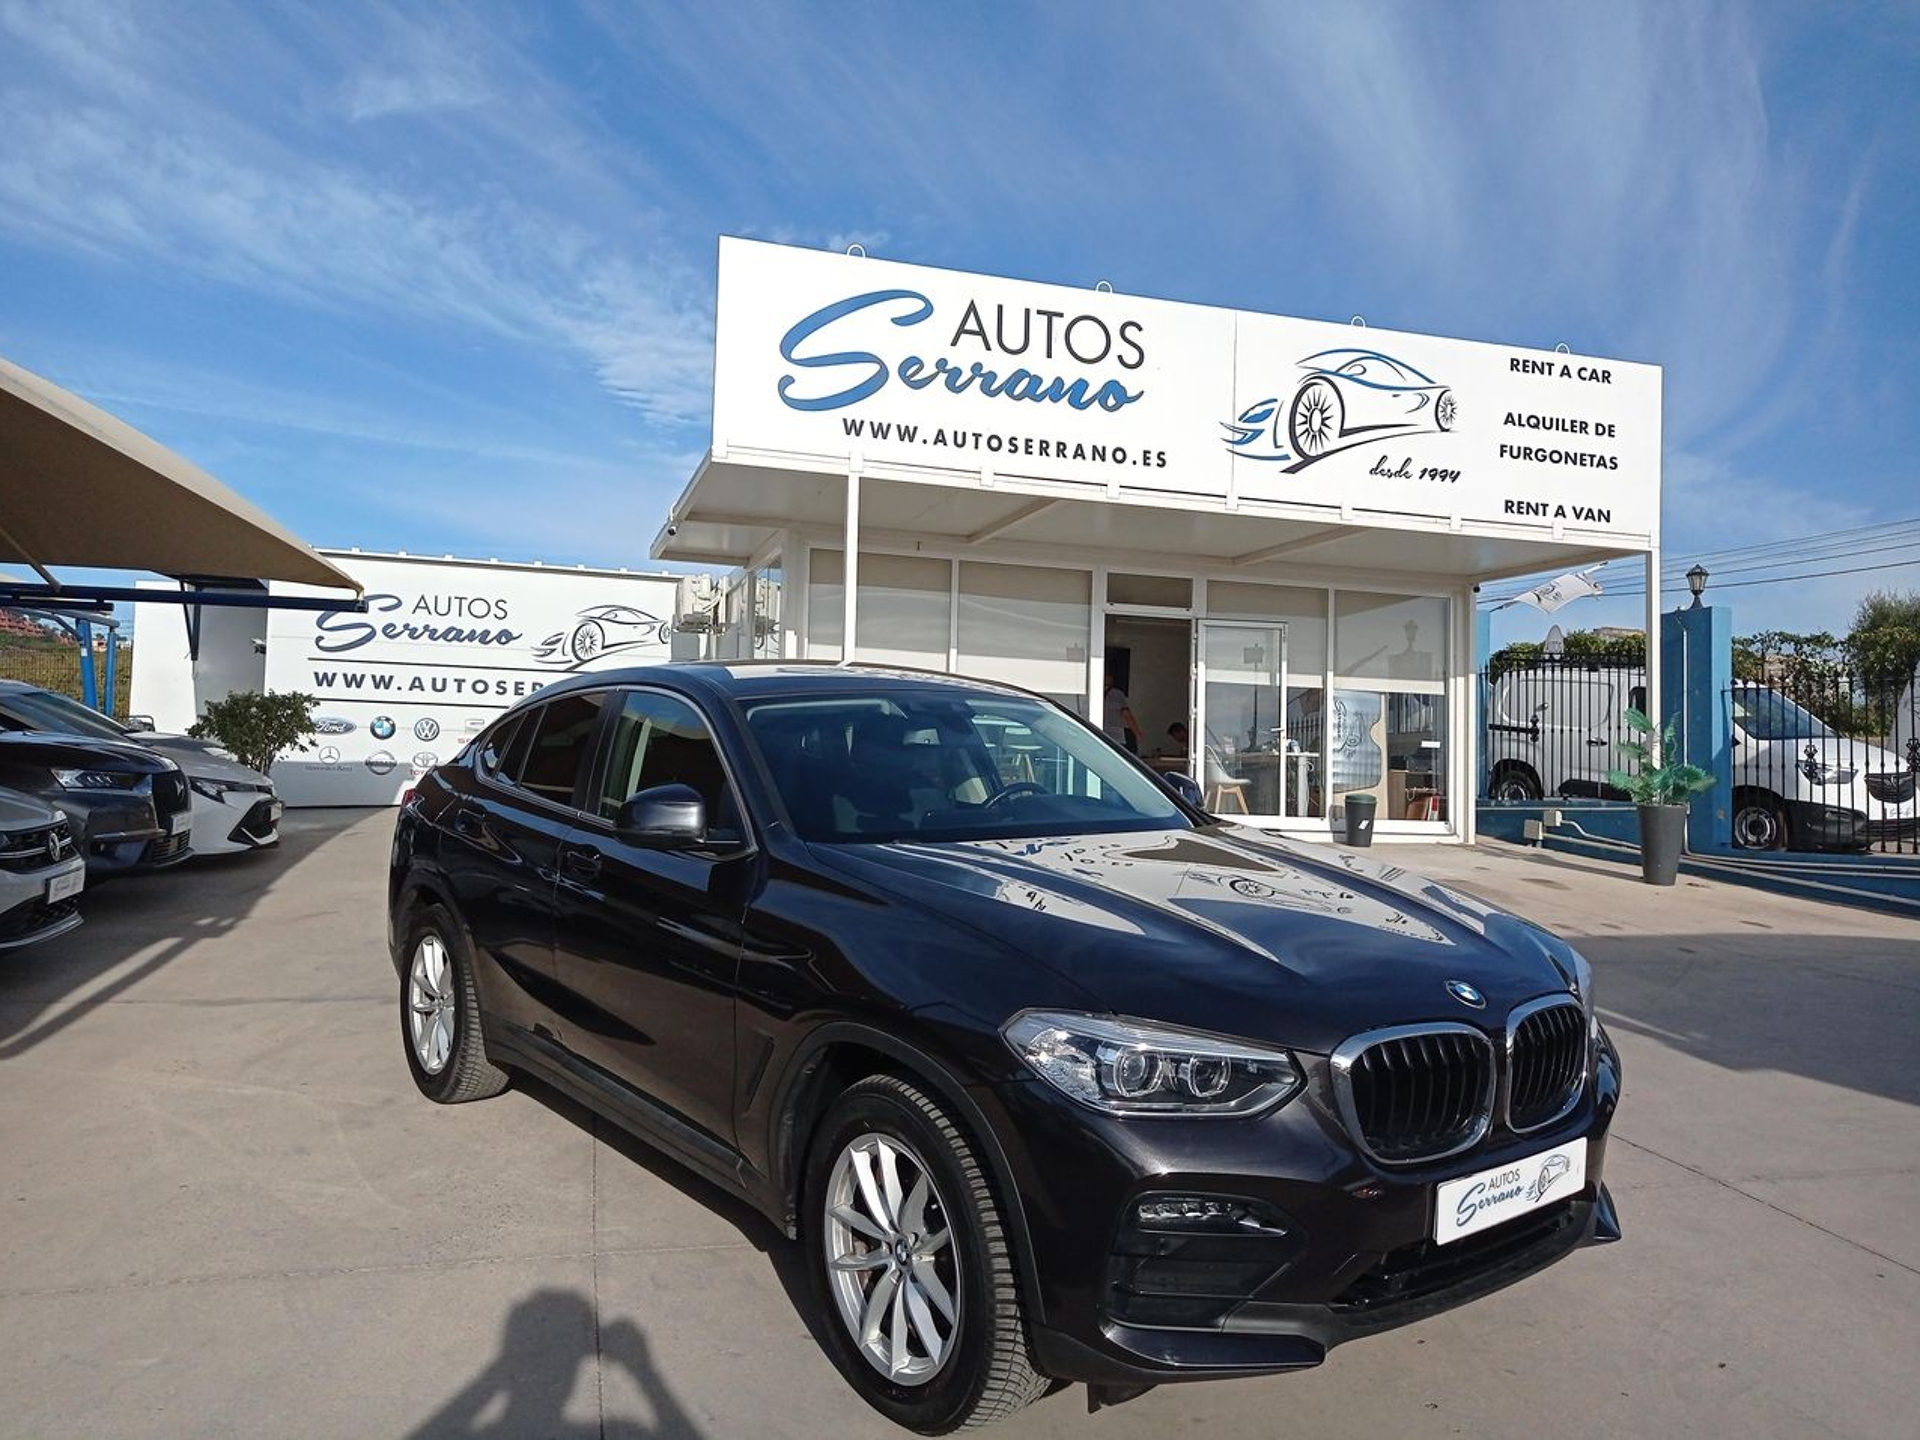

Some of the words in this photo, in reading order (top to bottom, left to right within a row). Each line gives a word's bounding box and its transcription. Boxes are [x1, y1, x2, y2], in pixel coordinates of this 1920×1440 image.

[950, 299, 1145, 369] AUTOS
[777, 289, 1145, 412] Serrano
[1510, 358, 1555, 376] RENT
[1559, 364, 1572, 379] A
[1577, 366, 1612, 384] CAR
[1503, 411, 1589, 436] ALQUILER
[1595, 422, 1616, 438] DE
[842, 417, 1168, 469] WWW.AUTOSERRANO.ES
[1369, 455, 1413, 479] desde
[1419, 467, 1461, 483] 1994
[1499, 444, 1619, 470] FURGONETAS
[1504, 499, 1549, 517] RENT
[1553, 504, 1567, 519] A
[1572, 505, 1611, 523] VAN
[412, 594, 508, 620] AUTOS
[315, 594, 523, 652] Serrano
[1487, 1168, 1521, 1191] AUTOS
[1456, 1182, 1525, 1227] Serrano
